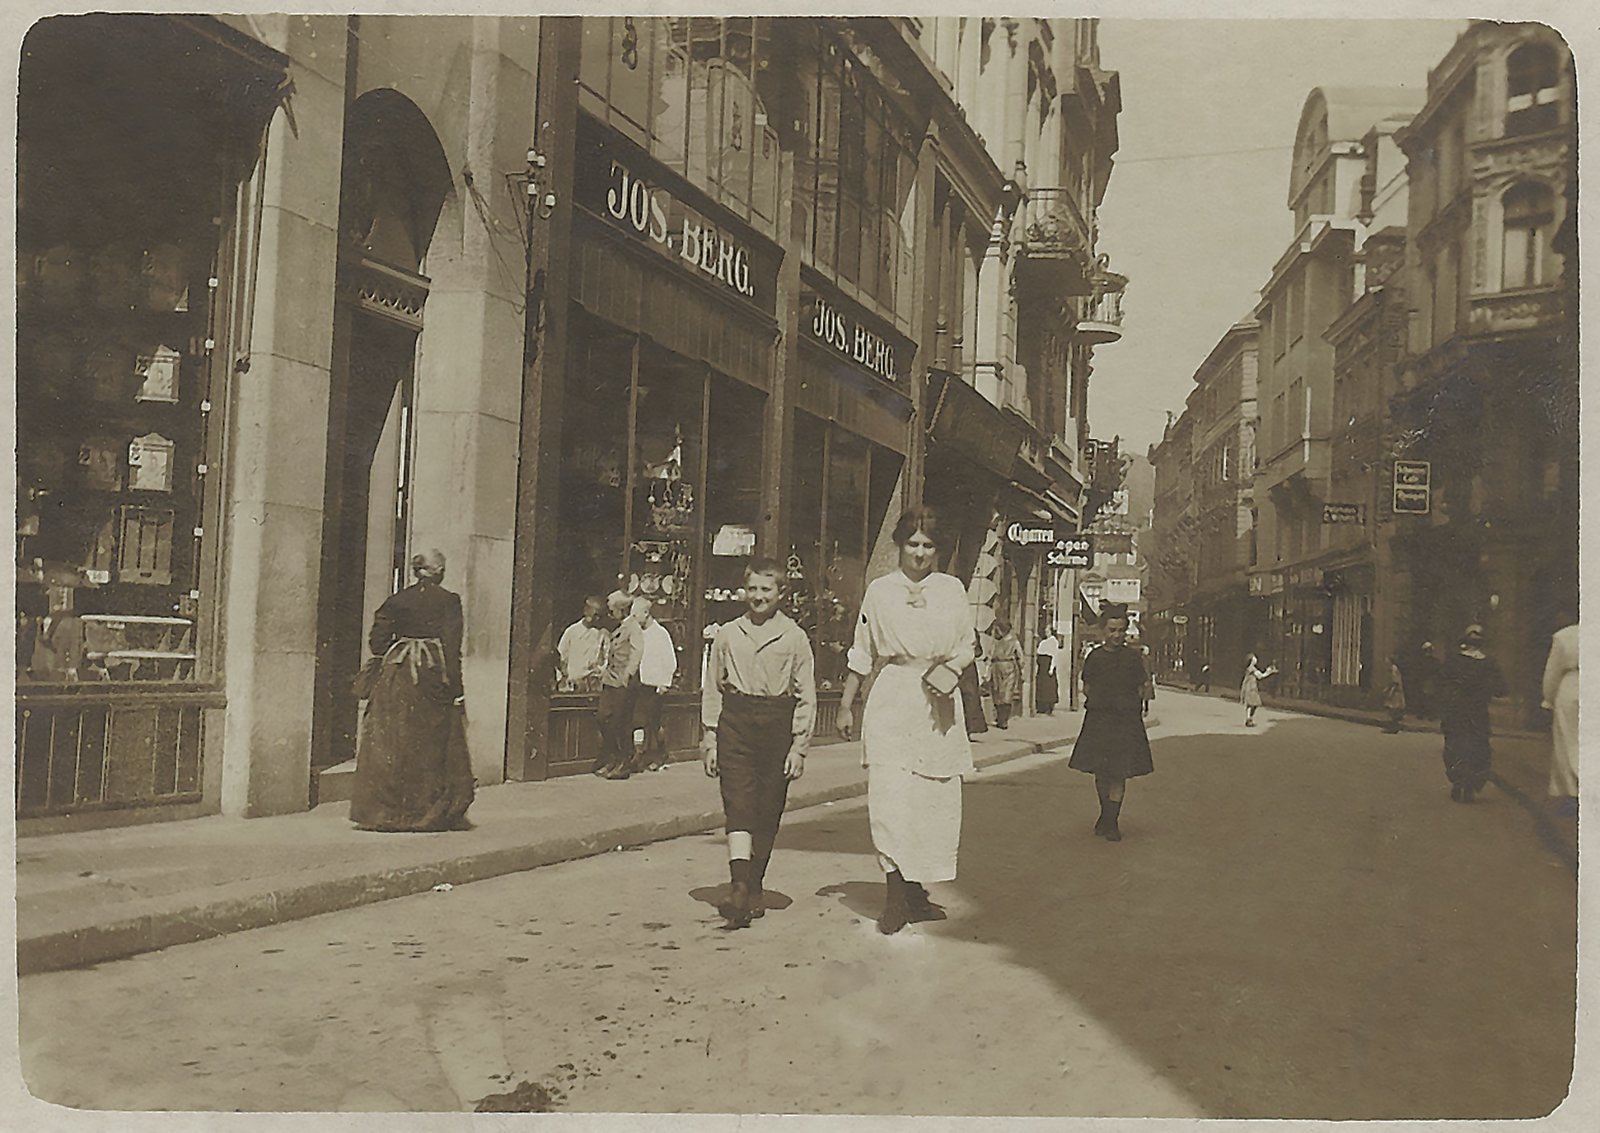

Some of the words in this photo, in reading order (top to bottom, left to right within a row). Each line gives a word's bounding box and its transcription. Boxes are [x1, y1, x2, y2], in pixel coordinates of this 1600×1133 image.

[607, 160, 672, 249] JOS.
[680, 215, 754, 297] BERG.
[813, 298, 849, 354] JOS.
[853, 322, 897, 382] BERG.
[1055, 540, 1090, 556] egen
